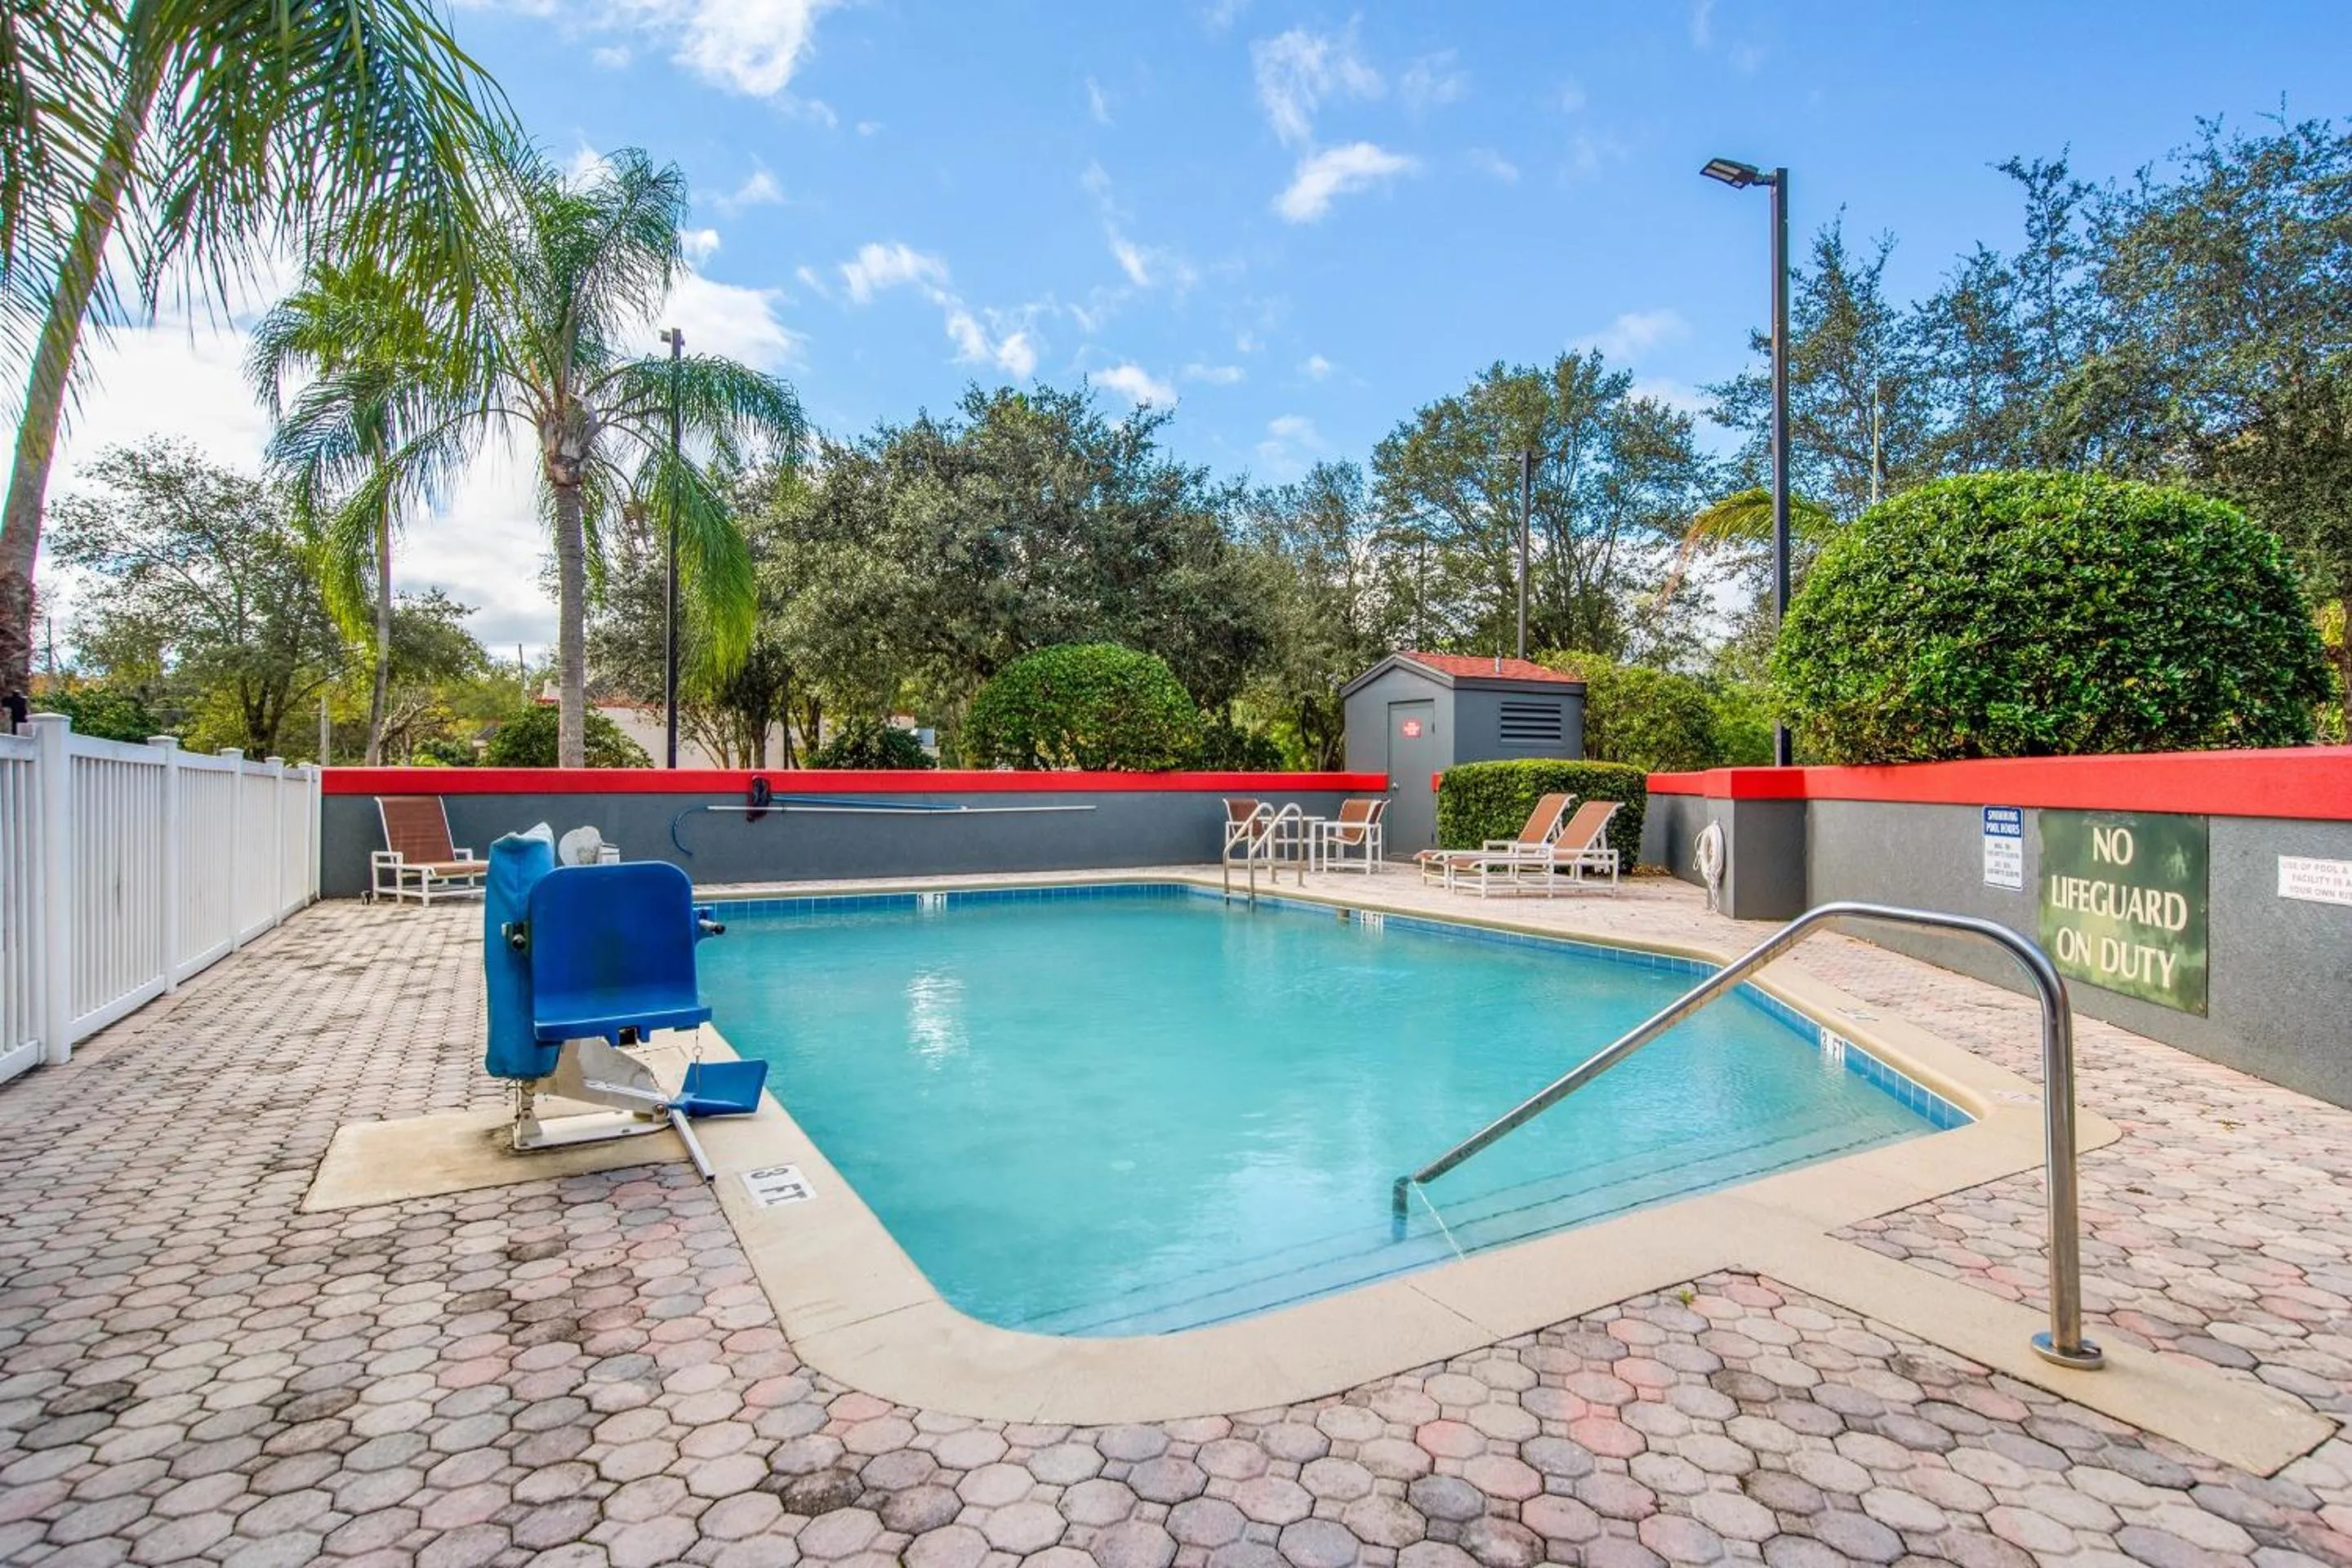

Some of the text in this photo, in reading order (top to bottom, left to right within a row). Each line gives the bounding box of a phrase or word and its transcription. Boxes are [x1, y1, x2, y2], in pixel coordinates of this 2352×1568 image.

[2092, 826, 2134, 866] NO
[2292, 873, 2331, 884] FACILITY
[2314, 863, 2338, 873] POOL
[2051, 875, 2188, 931] LIFEGUARD
[2289, 886, 2312, 895] YOUR
[2314, 889, 2336, 898] OWN
[2056, 927, 2176, 988] ON DUTY
